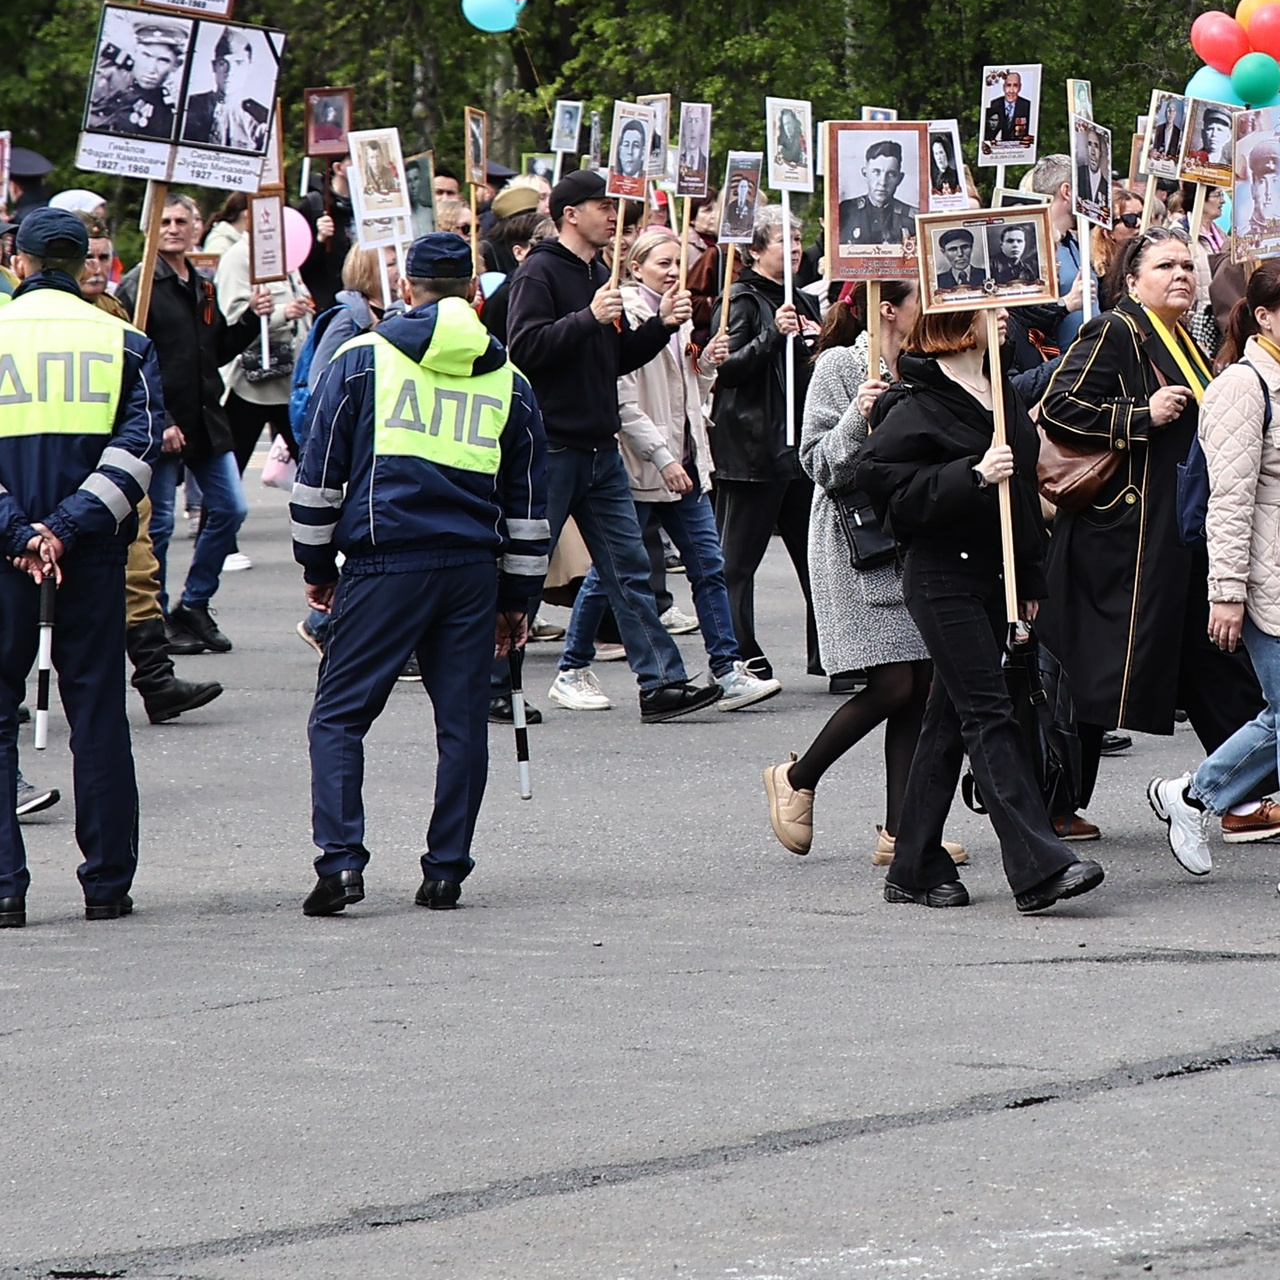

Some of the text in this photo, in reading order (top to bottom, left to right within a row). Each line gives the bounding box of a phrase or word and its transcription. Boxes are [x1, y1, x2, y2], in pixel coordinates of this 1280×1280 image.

[95, 159, 119, 170] 1927
[190, 169, 212, 180] 1927
[221, 174, 244, 185] 1945
[385, 379, 503, 448] ДПС
